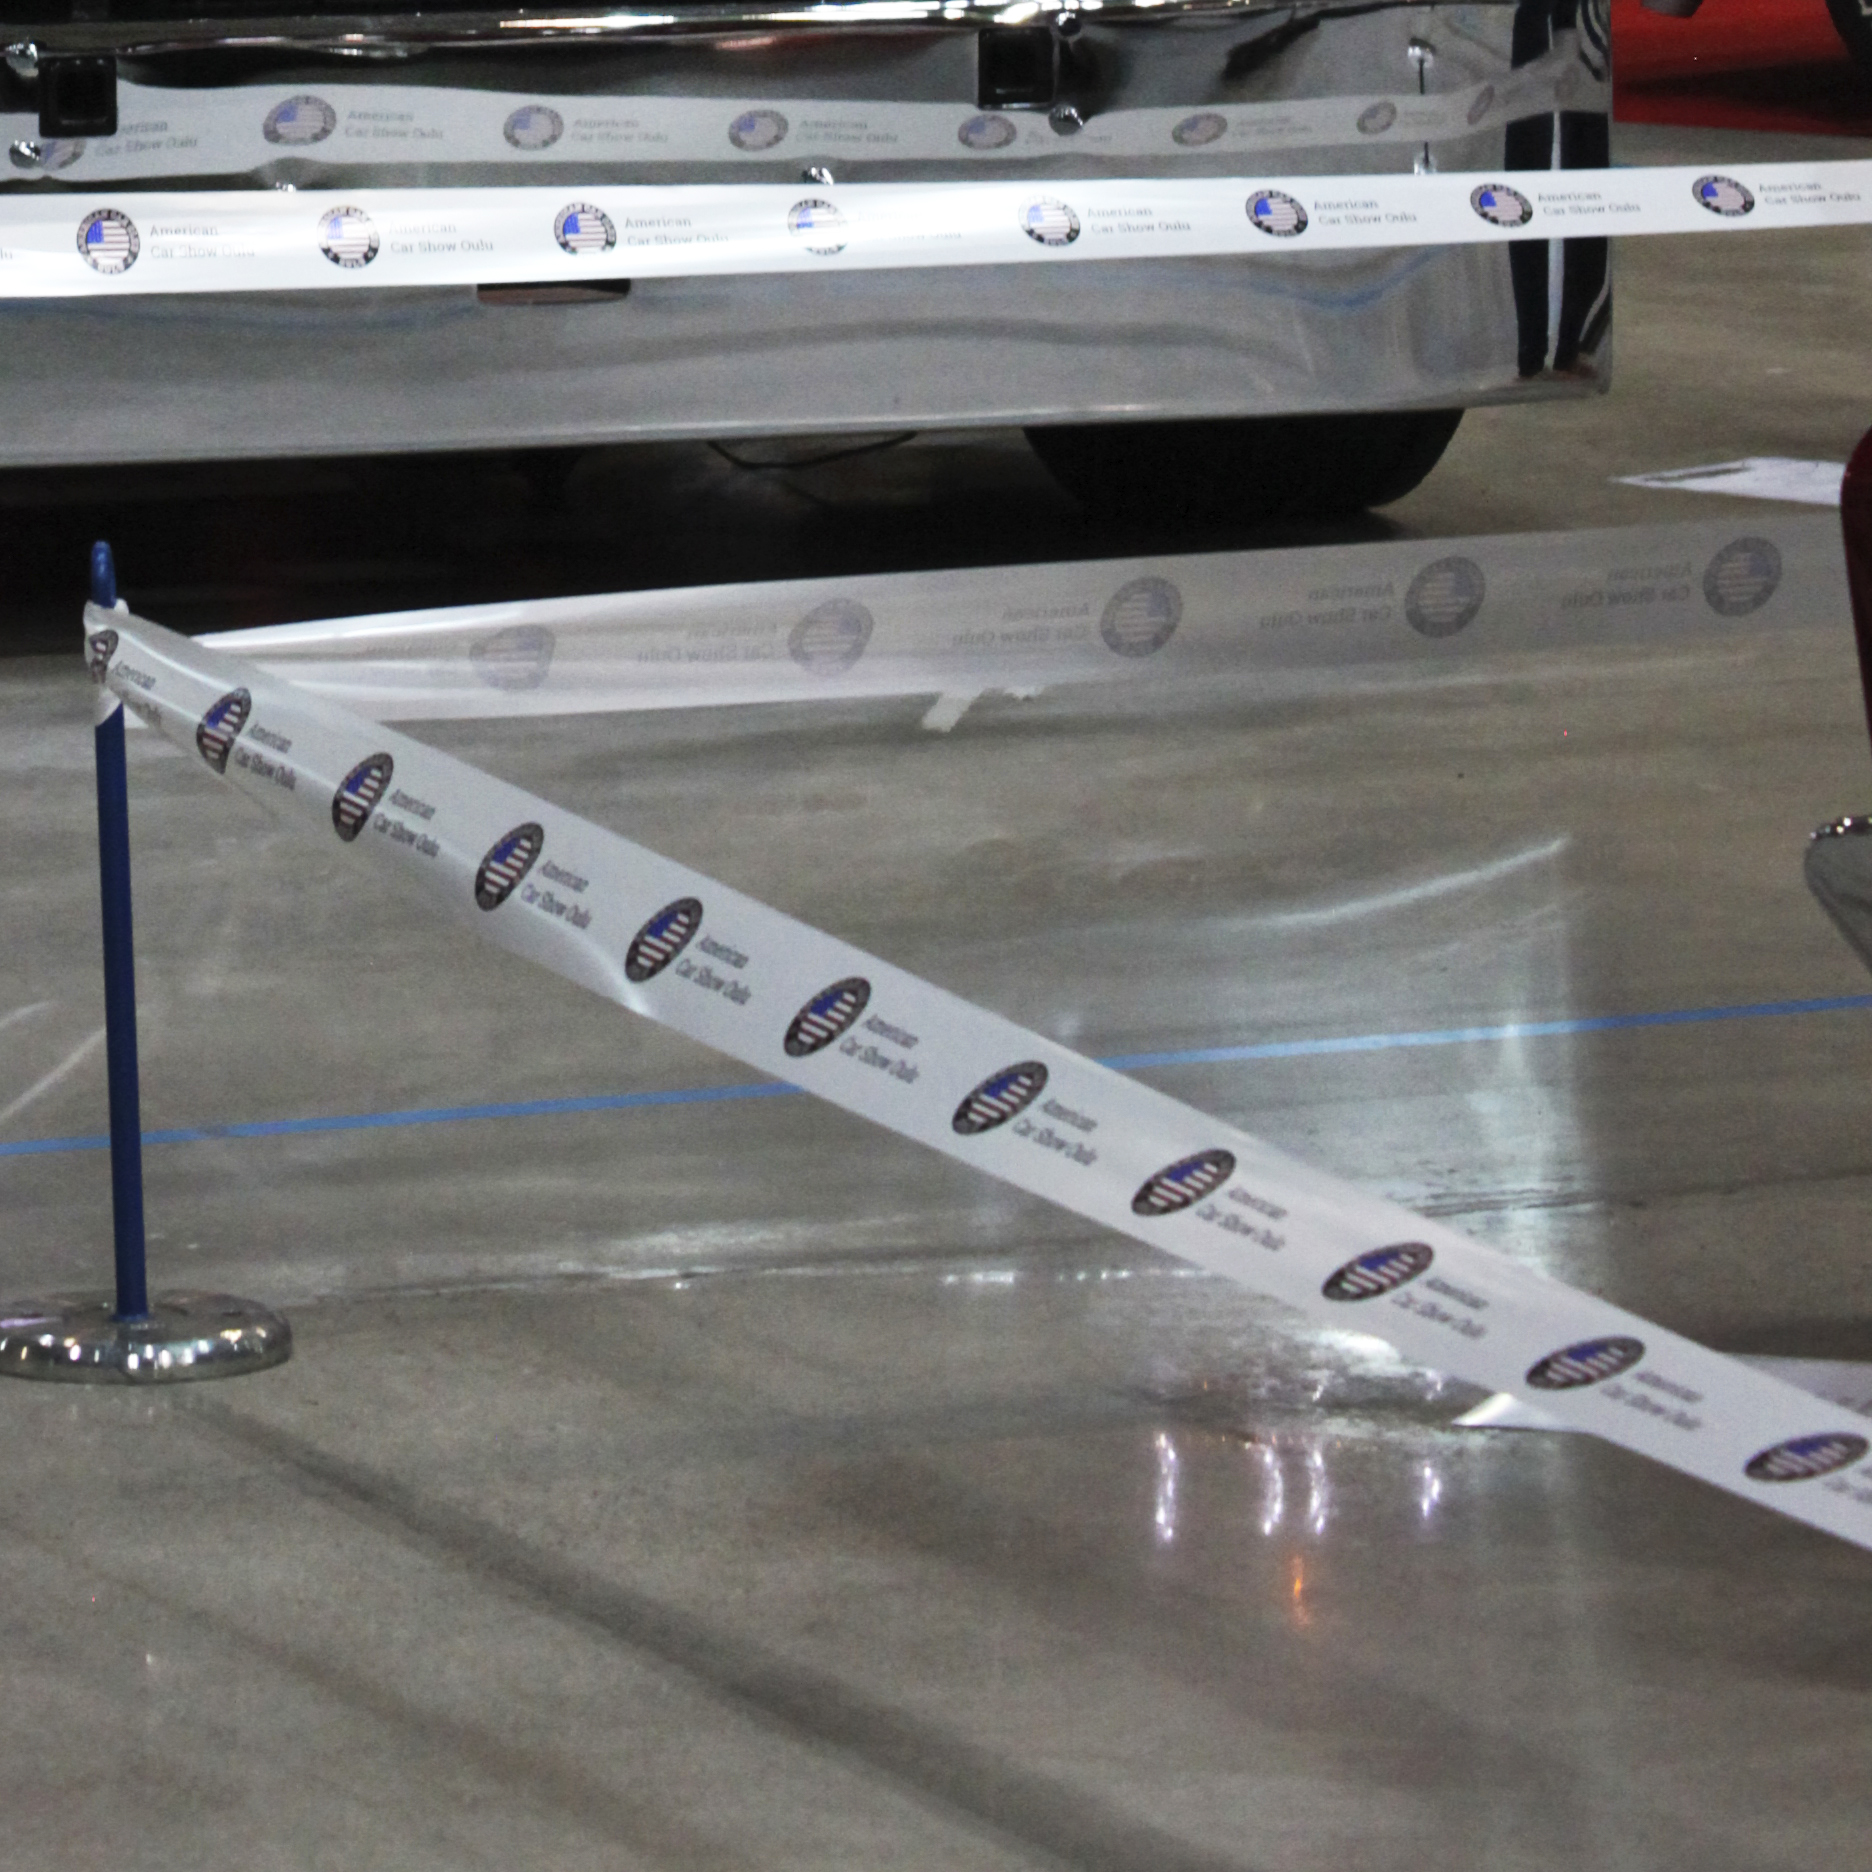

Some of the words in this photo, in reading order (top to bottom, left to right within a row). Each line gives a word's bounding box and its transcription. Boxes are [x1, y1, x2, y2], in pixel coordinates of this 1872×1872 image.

[1758, 182, 1822, 194] American
[1537, 191, 1602, 204] American
[1764, 195, 1787, 206] Car
[1789, 193, 1827, 205] Show
[1313, 200, 1379, 212] American
[1543, 205, 1566, 217] Car
[1568, 204, 1606, 216] Show
[1087, 207, 1153, 219] American
[1318, 215, 1341, 226] Car
[1344, 214, 1382, 226] Show
[1385, 213, 1417, 224] Oulu
[388, 221, 457, 234] American
[624, 216, 692, 229] American
[1090, 224, 1114, 234] Car
[1117, 222, 1155, 234] Show
[1158, 221, 1191, 232] Oulu
[150, 224, 219, 237] American
[390, 241, 414, 254] Car
[418, 240, 458, 253] Show
[461, 239, 494, 252] Oulu
[627, 235, 650, 246] Car
[654, 234, 693, 246] Show
[150, 245, 175, 259] Car
[249, 723, 293, 754] American
[234, 747, 251, 769] Car
[251, 752, 276, 781] Show
[390, 787, 436, 822] American
[373, 812, 392, 834] Car
[392, 818, 419, 848] Show
